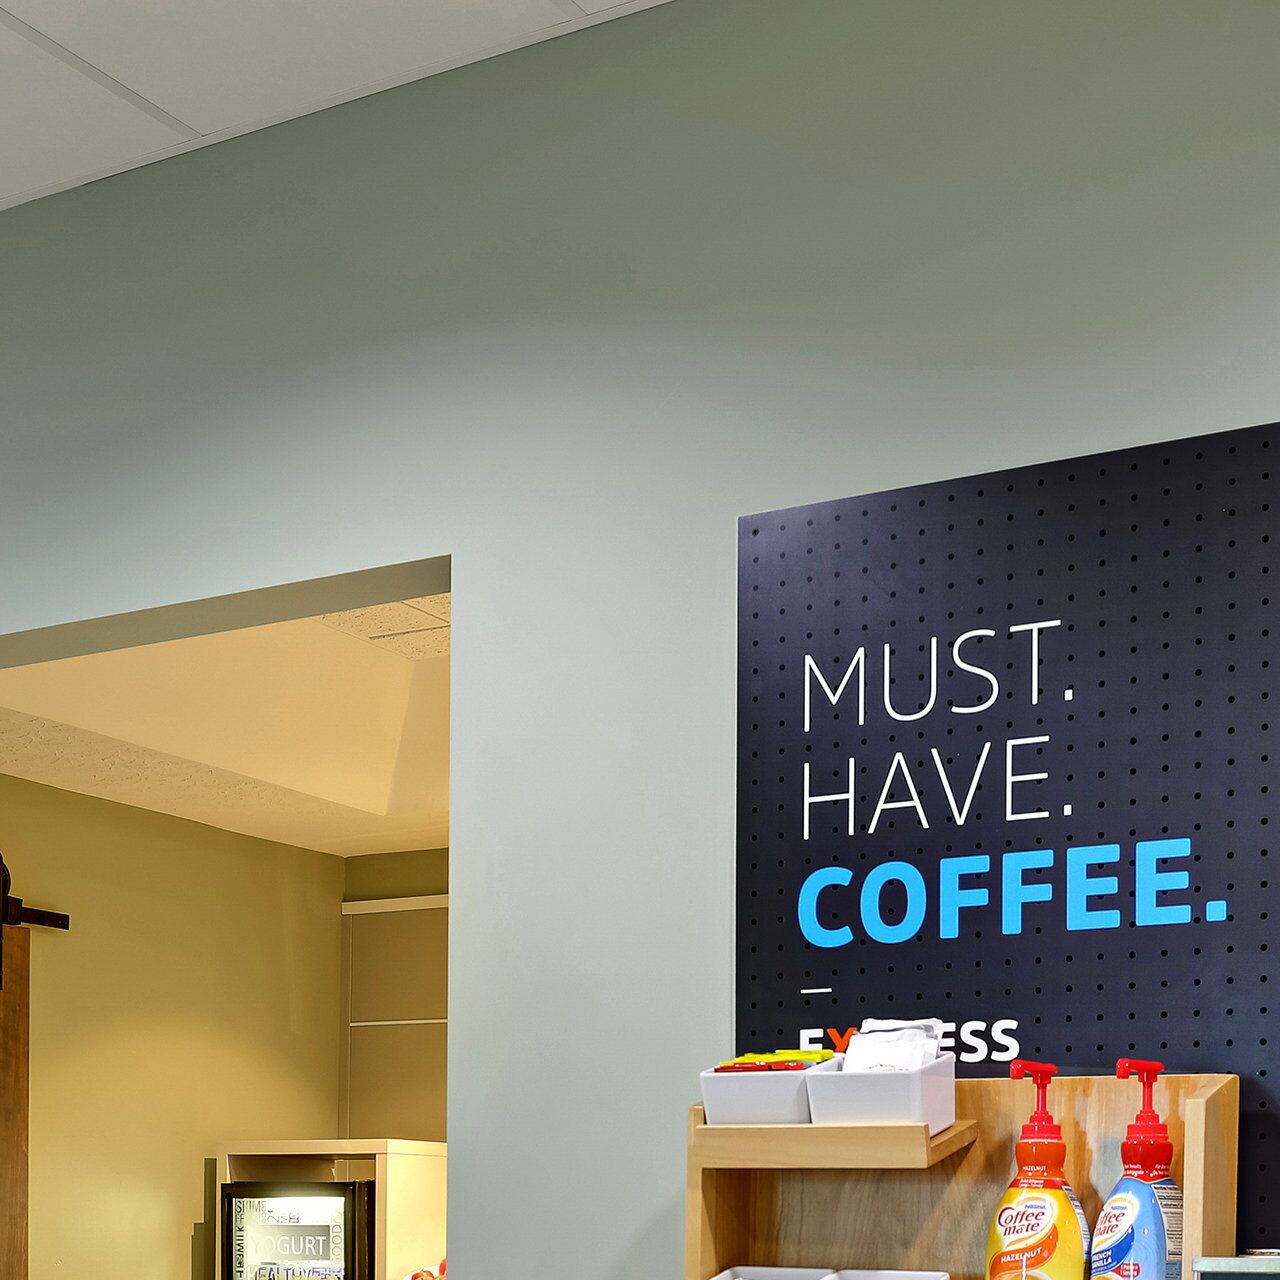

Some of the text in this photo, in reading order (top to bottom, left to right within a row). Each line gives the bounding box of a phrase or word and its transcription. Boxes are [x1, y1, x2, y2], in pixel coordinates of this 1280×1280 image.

[803, 619, 1073, 733] MUST.
[802, 735, 1073, 841] HAVE.
[797, 837, 1229, 949] COFFEE.
[998, 1206, 1046, 1228] Coffee
[1003, 1222, 1040, 1238] mate
[250, 1235, 327, 1257] YOGURT
[1000, 1246, 1043, 1264] HAZELNUT
